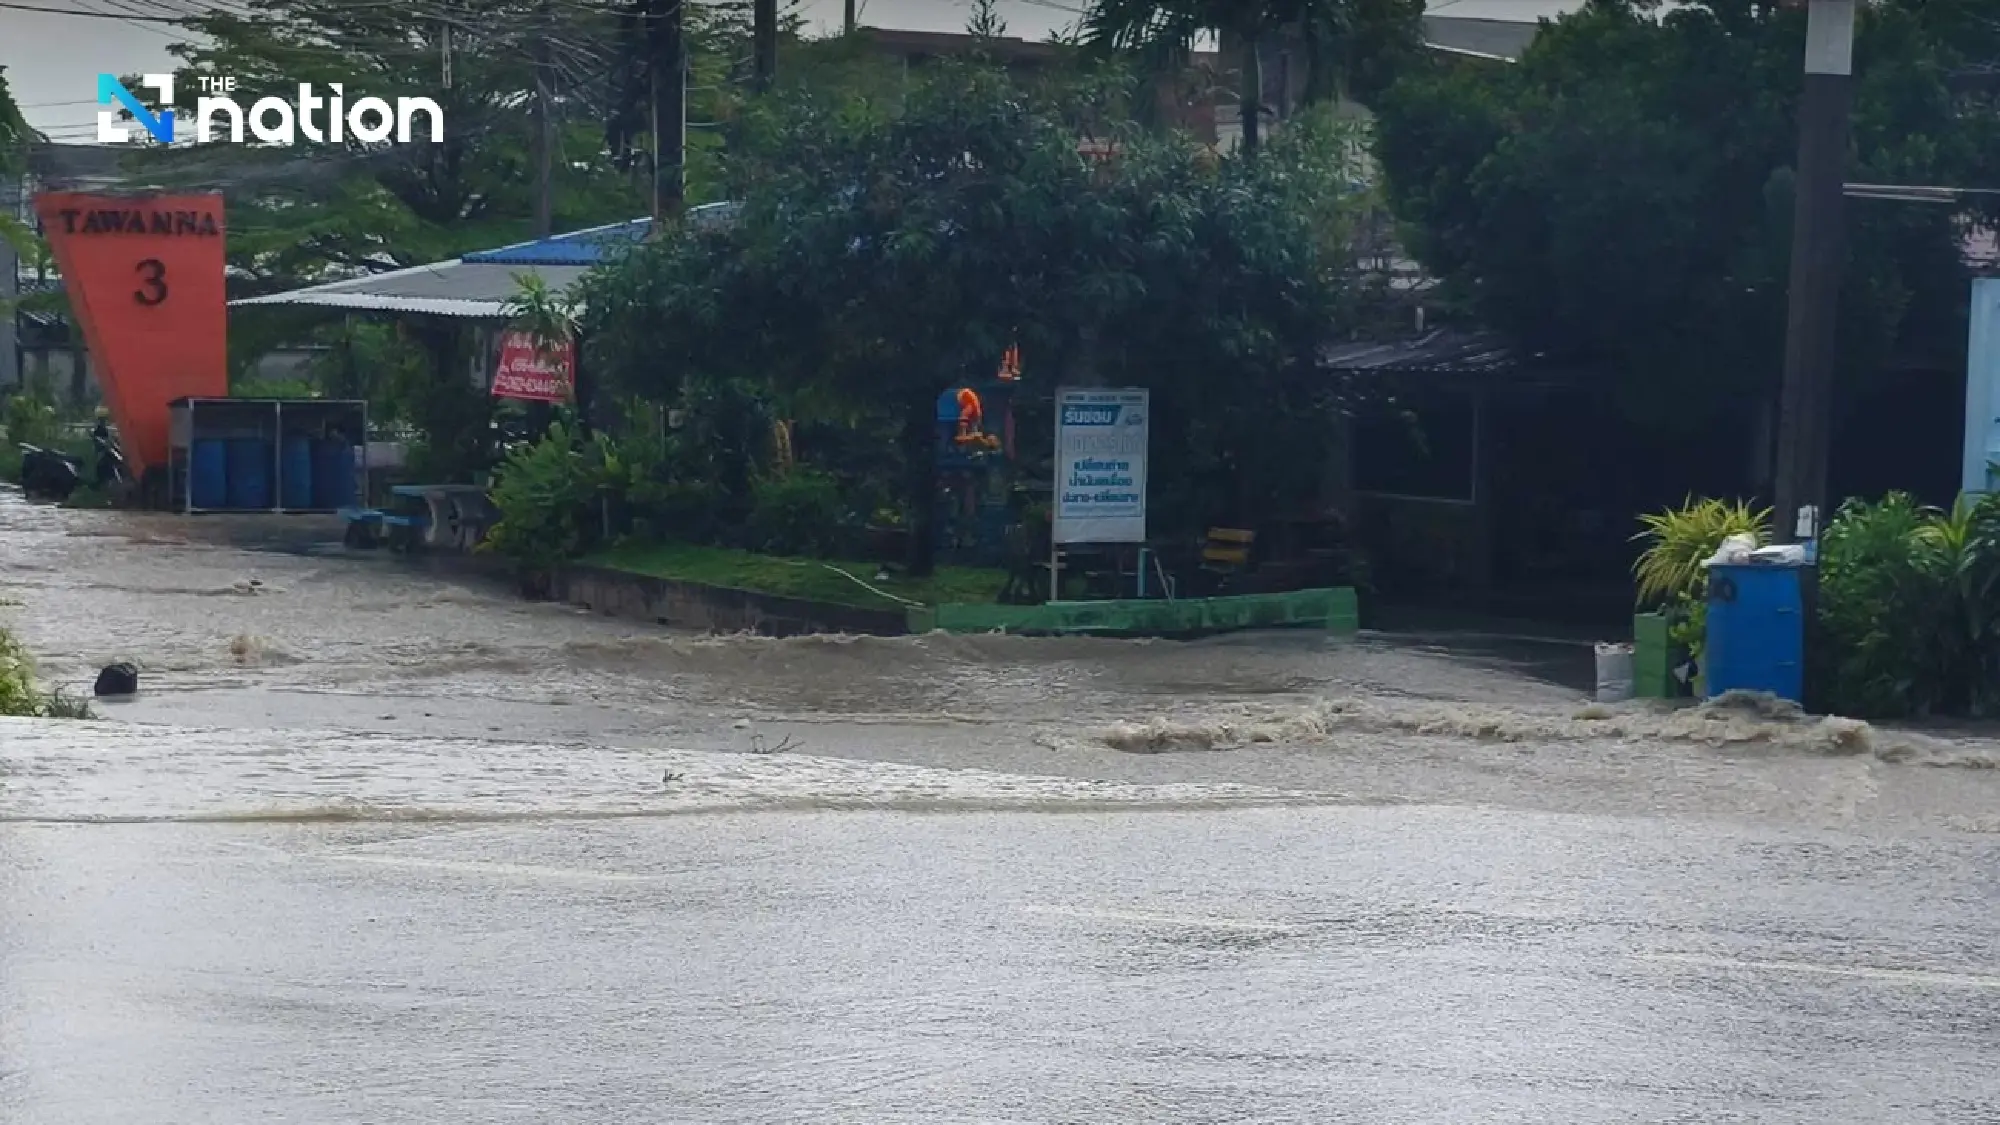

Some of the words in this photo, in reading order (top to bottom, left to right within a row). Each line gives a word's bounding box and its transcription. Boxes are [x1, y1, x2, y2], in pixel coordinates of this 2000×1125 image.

[60, 208, 219, 236] TAWANNA
[134, 258, 168, 306] 3
[1064, 406, 1112, 424] รับซ่อม
